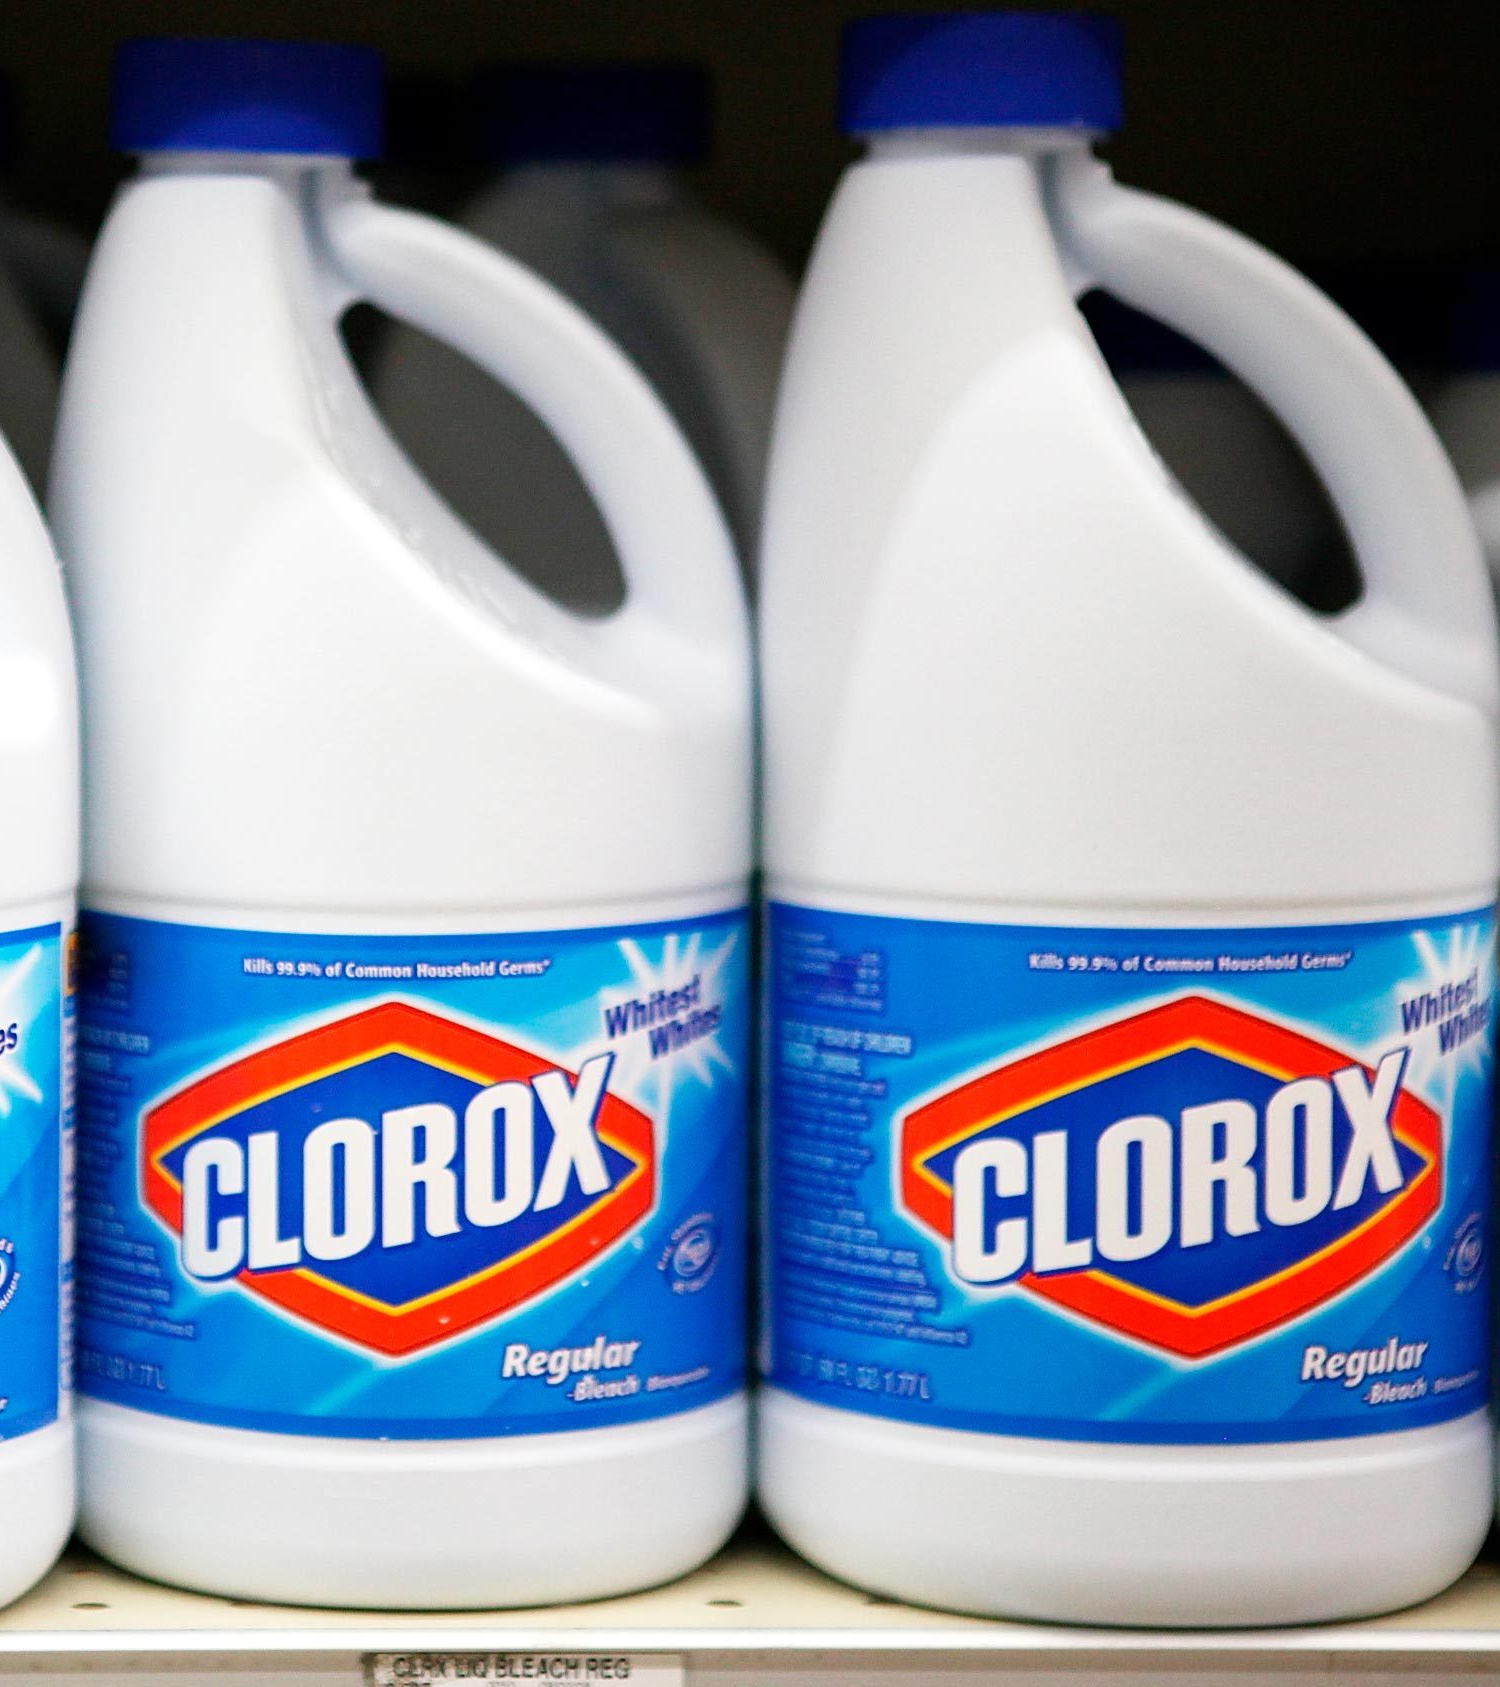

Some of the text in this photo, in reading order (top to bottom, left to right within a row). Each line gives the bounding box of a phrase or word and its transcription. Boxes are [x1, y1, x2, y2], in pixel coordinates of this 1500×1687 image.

[243, 958, 273, 975] Kills
[277, 961, 321, 977] 99.9%
[325, 962, 342, 977] of
[345, 963, 412, 978] Common
[416, 960, 496, 978] Household
[1028, 954, 1064, 970] Kills
[1067, 956, 1118, 972] 99.9%
[1121, 955, 1140, 972] of
[1144, 956, 1214, 972] Common
[1218, 953, 1298, 972] Household
[604, 973, 700, 1039] Whitest
[1401, 966, 1478, 1034] Whitest
[648, 1003, 721, 1060] Whites
[182, 1051, 614, 1281] CLOROX
[952, 1047, 1409, 1286] CLOROX
[502, 1335, 641, 1385] Regular
[1300, 1336, 1429, 1388] Regular
[496, 1656, 579, 1679] BLEACH
[585, 1657, 630, 1679] REG
